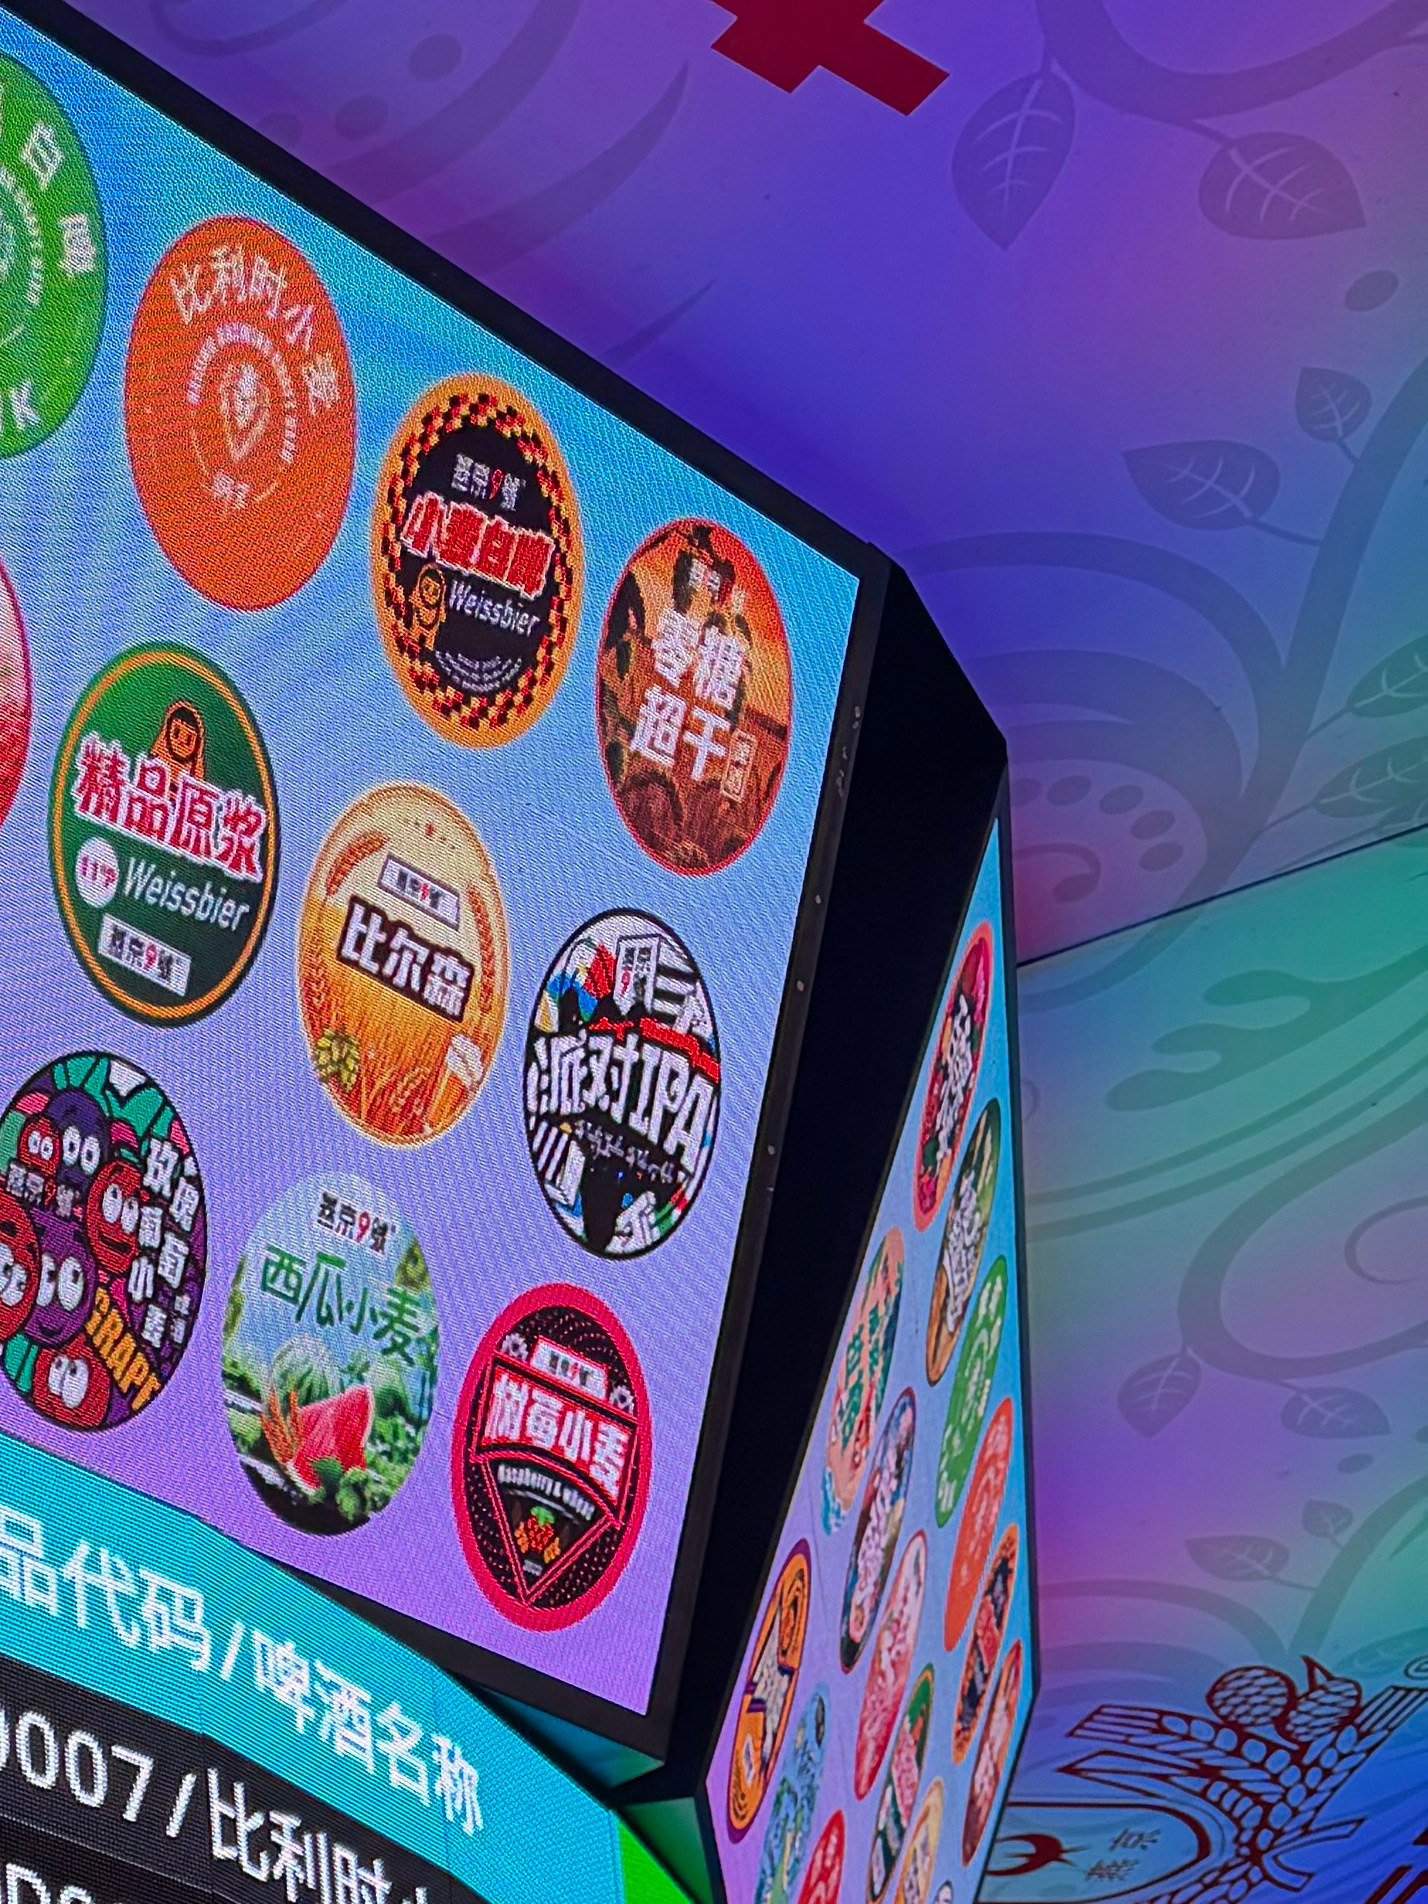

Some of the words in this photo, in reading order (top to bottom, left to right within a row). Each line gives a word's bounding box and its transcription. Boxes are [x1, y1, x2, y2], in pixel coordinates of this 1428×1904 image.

[170, 244, 339, 416] 比利时小麦
[448, 580, 540, 638] Weissbier
[651, 608, 744, 708] 零糖
[631, 689, 733, 778] 超干
[74, 734, 267, 880] 精品原浆
[125, 858, 248, 929] Weissbier
[342, 902, 472, 1015] 比尔森
[529, 1029, 715, 1177] 派对IPA
[320, 1192, 391, 1252] 燕京9號
[261, 1246, 422, 1366] 西瓜小麦
[488, 1374, 634, 1489] 树莓小麦
